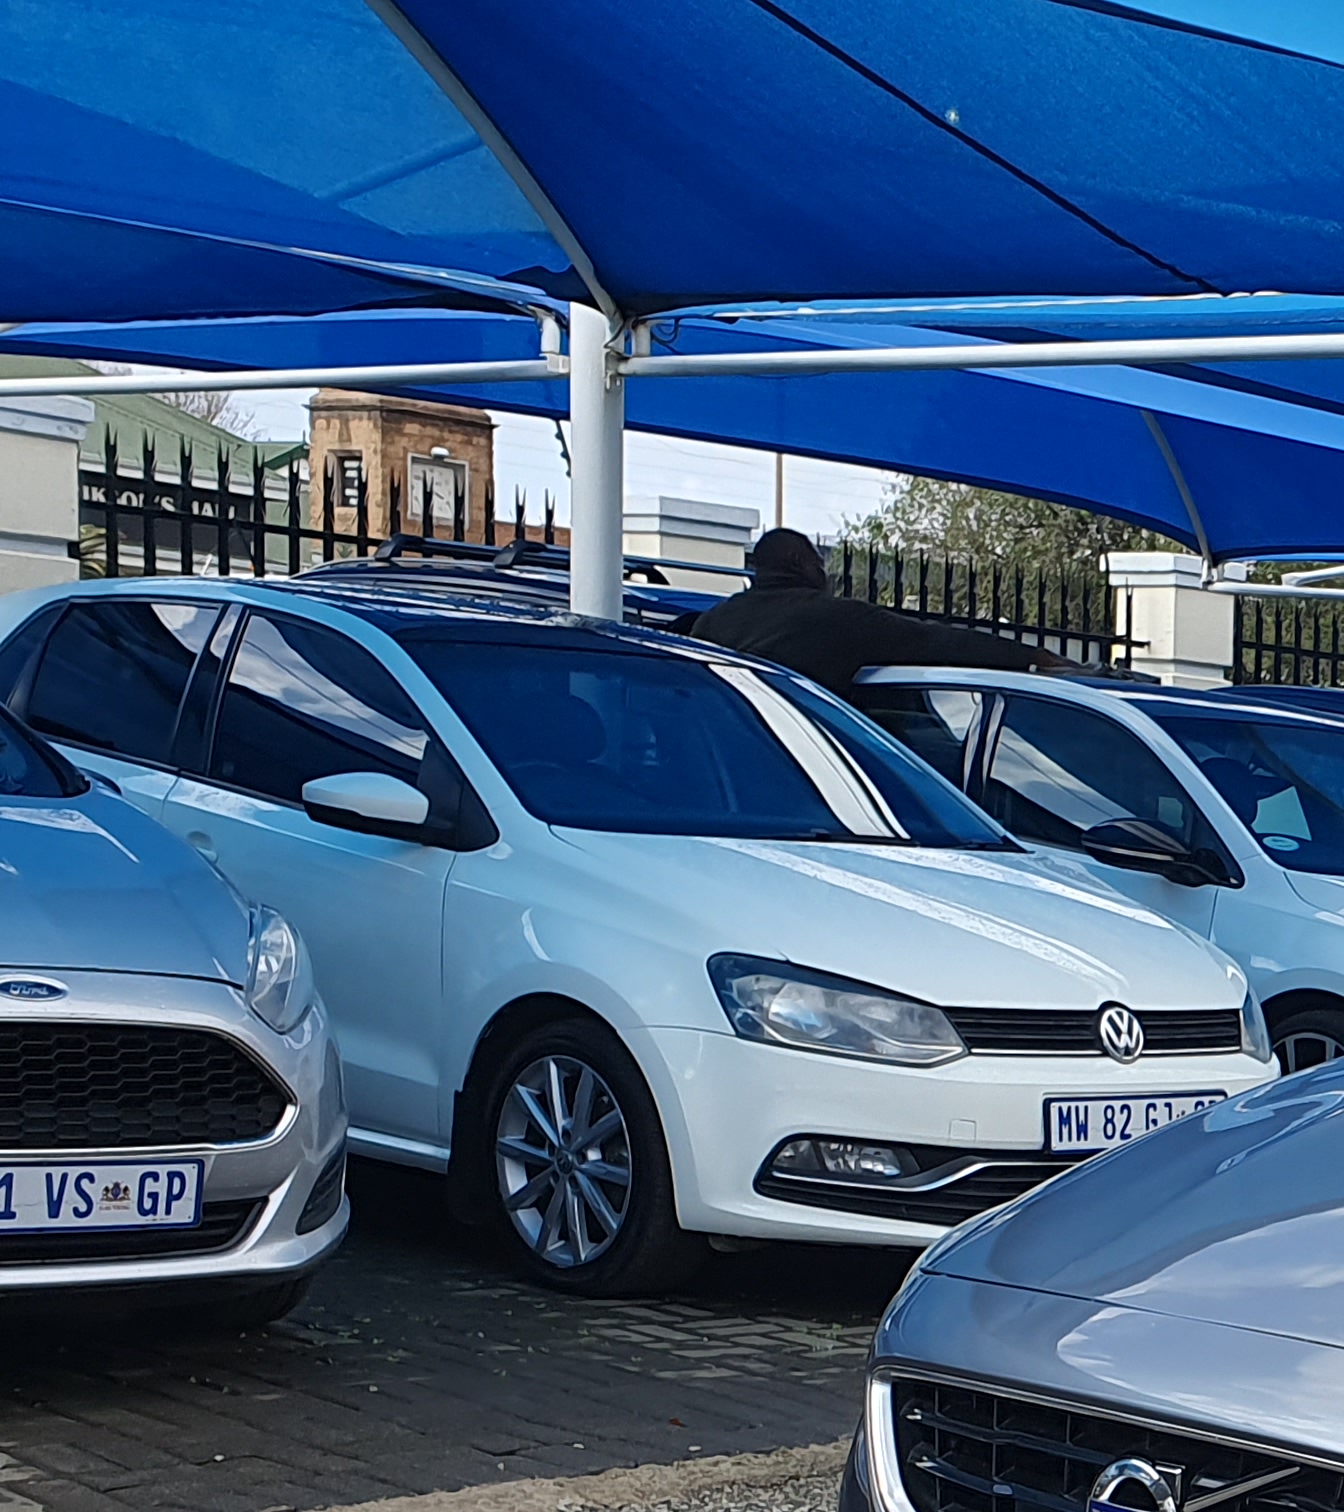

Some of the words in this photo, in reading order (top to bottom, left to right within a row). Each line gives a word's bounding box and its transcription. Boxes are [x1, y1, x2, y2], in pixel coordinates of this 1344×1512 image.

[1057, 1105, 1089, 1143] MW
[1103, 1104, 1132, 1141] 82
[45, 1172, 96, 1219] VS
[137, 1171, 187, 1217] GP
